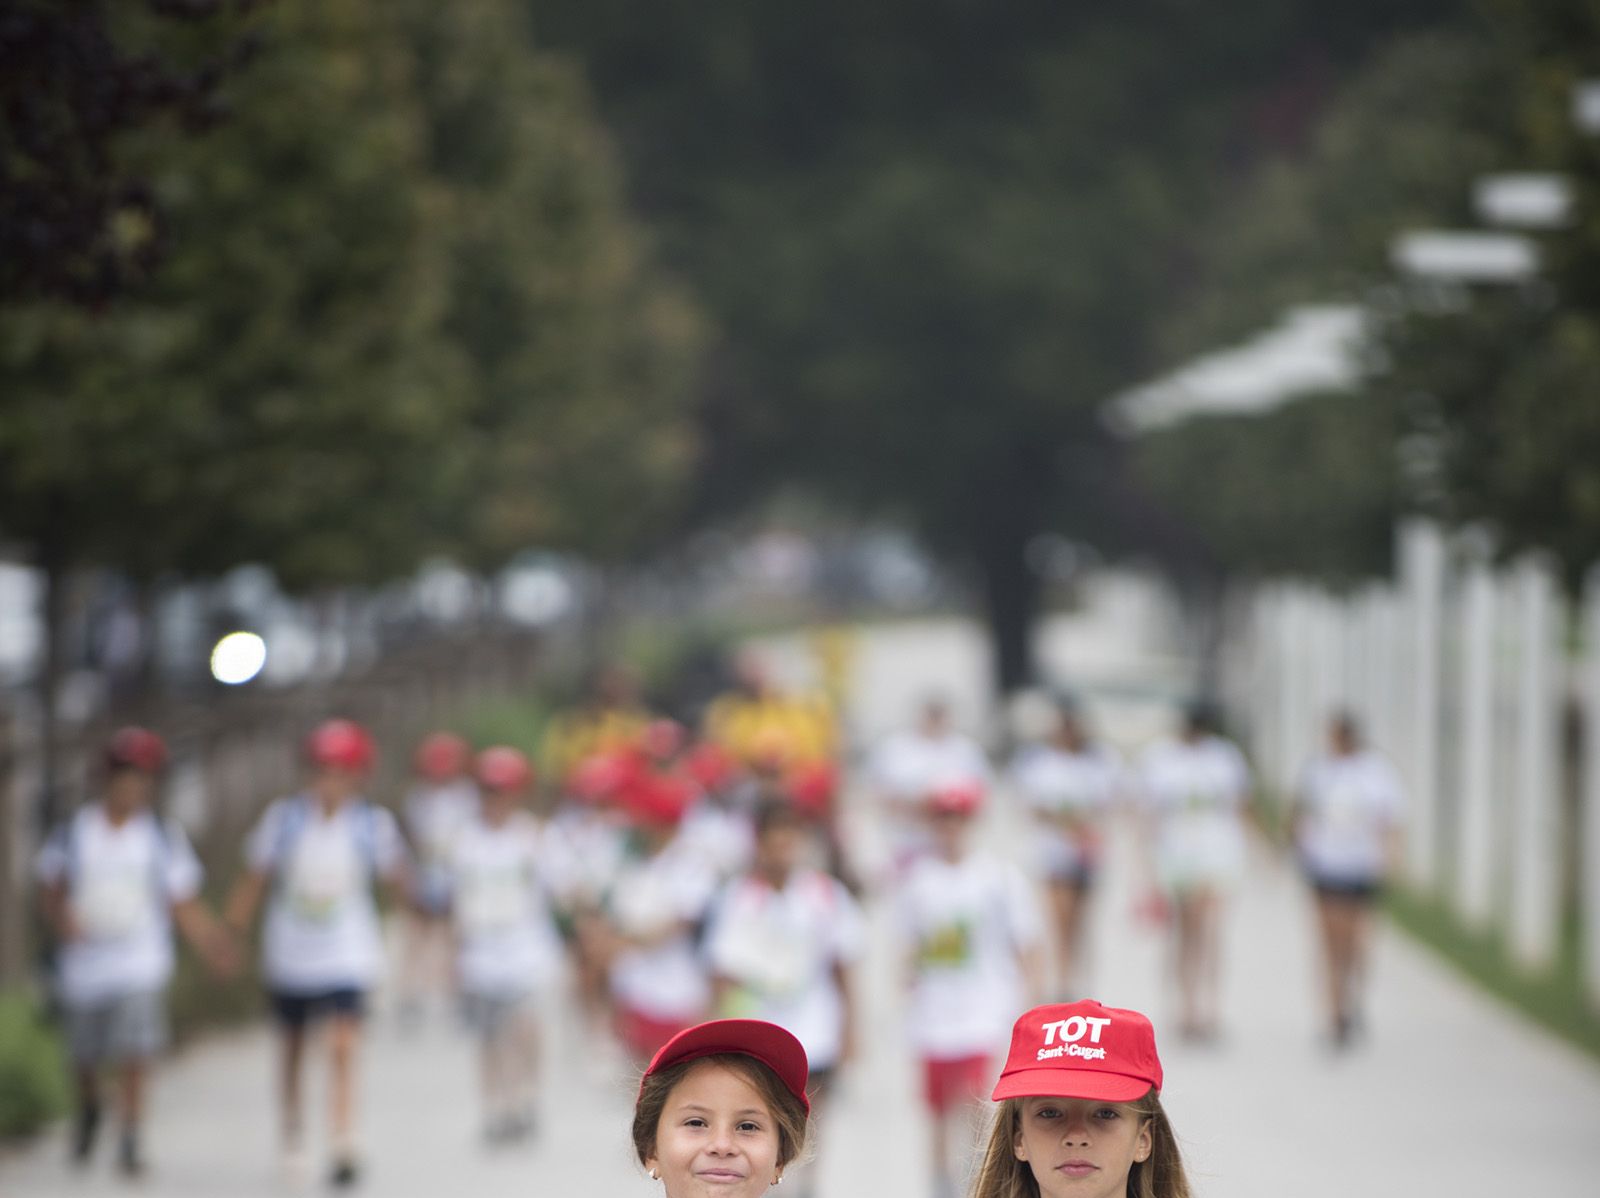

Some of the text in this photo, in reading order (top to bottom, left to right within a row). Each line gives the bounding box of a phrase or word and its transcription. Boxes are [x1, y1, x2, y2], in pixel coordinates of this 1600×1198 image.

[1041, 1015, 1111, 1046] TOT
[1037, 1044, 1107, 1061] Sant Cugat
